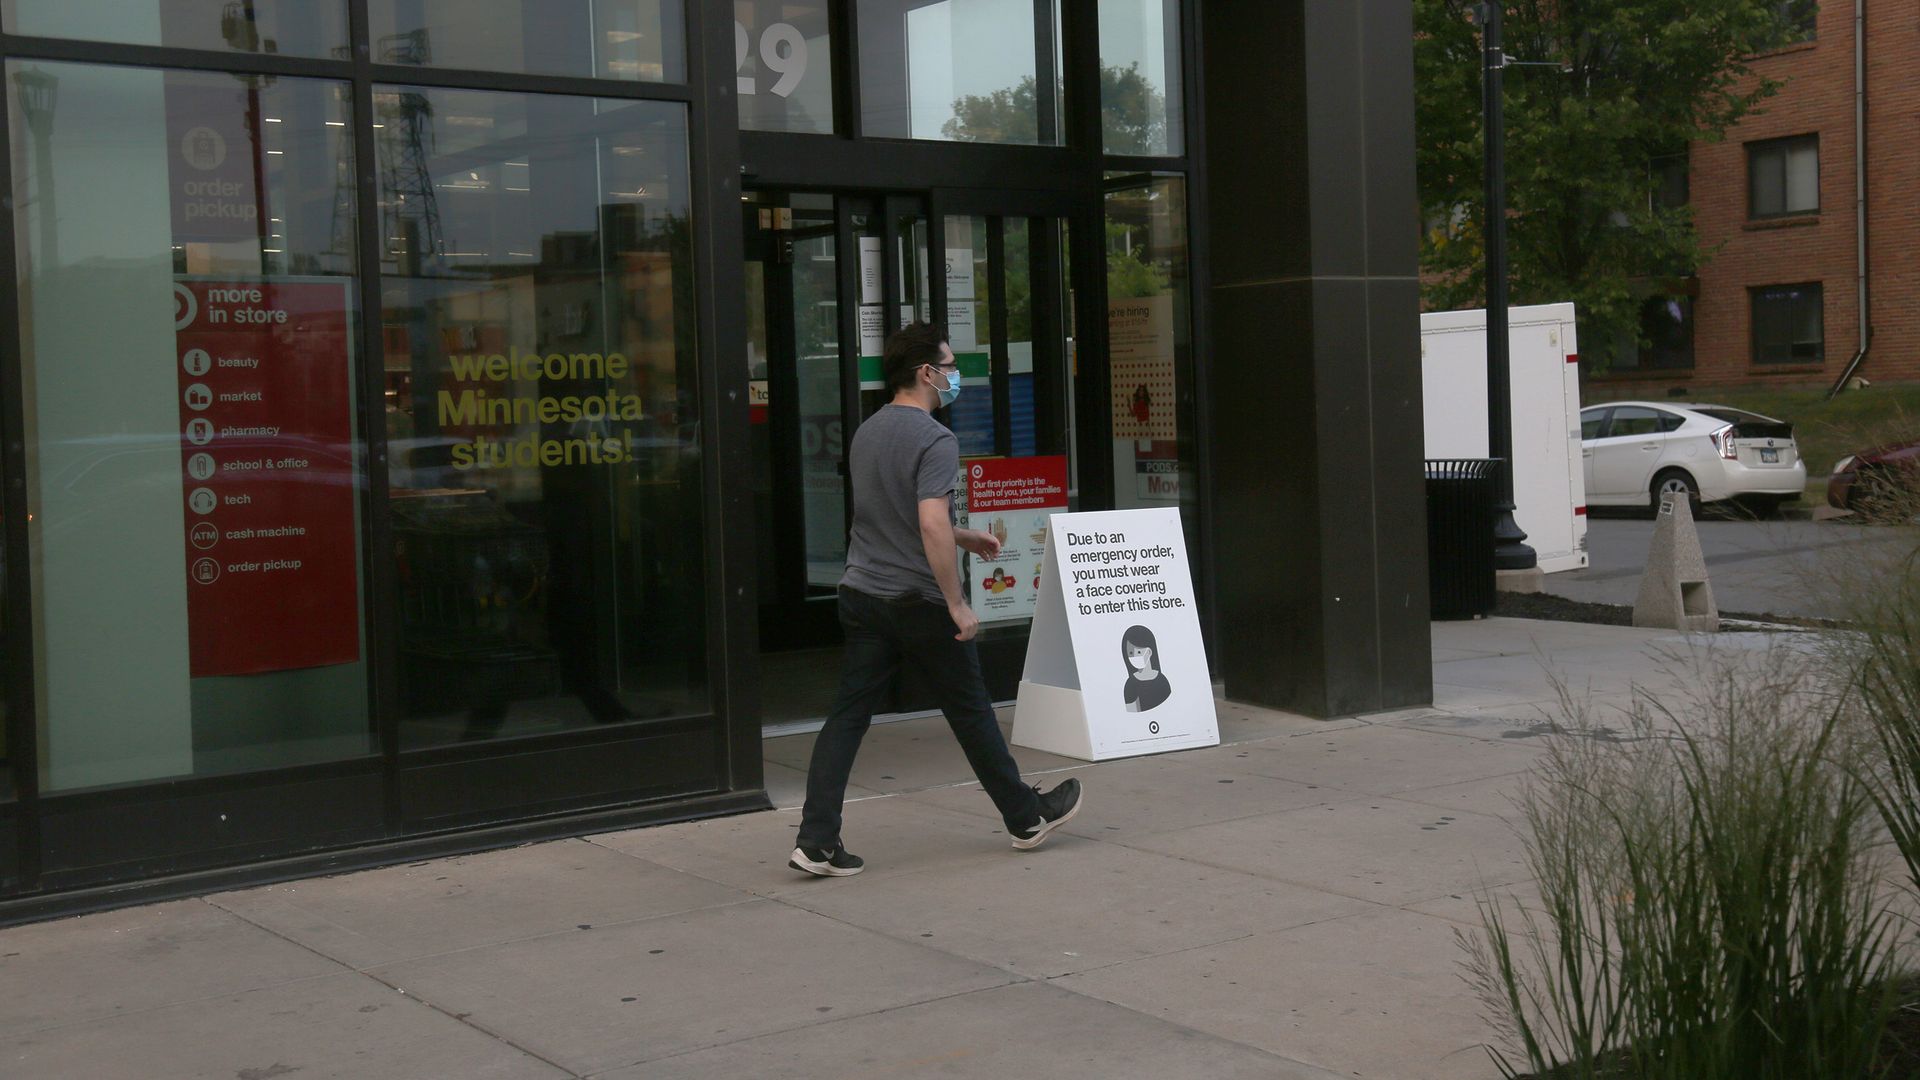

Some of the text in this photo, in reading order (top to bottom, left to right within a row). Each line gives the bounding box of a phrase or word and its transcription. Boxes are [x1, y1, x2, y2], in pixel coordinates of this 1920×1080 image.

[184, 178, 244, 196] order
[184, 198, 257, 222] pickup
[208, 288, 262, 303] more
[209, 305, 288, 324] in store
[1126, 306, 1150, 318] hiring
[218, 356, 260, 369] beauty
[449, 345, 628, 381] welcome
[220, 391, 263, 402] market
[437, 388, 644, 426] Minnesota
[221, 425, 280, 438] pharmacy
[451, 428, 633, 471] students!
[223, 457, 309, 471] school & office
[973, 477, 1046, 489] Our first priority is the
[973, 489, 995, 498] health
[996, 488, 1003, 497] of
[1004, 489, 1018, 498] you,
[1019, 487, 1035, 497] your
[1035, 485, 1061, 494] families
[224, 494, 252, 505] tech
[973, 496, 1044, 508] & our team members
[194, 530, 216, 541] ATM
[225, 525, 306, 540] cash machine
[1067, 532, 1125, 546] Due to an
[1070, 545, 1174, 564] emergency order,
[228, 559, 302, 573] order pickup
[1073, 564, 1160, 583] you must wear
[1076, 580, 1166, 598] a face covering
[1078, 596, 1185, 615] to enter this store.
